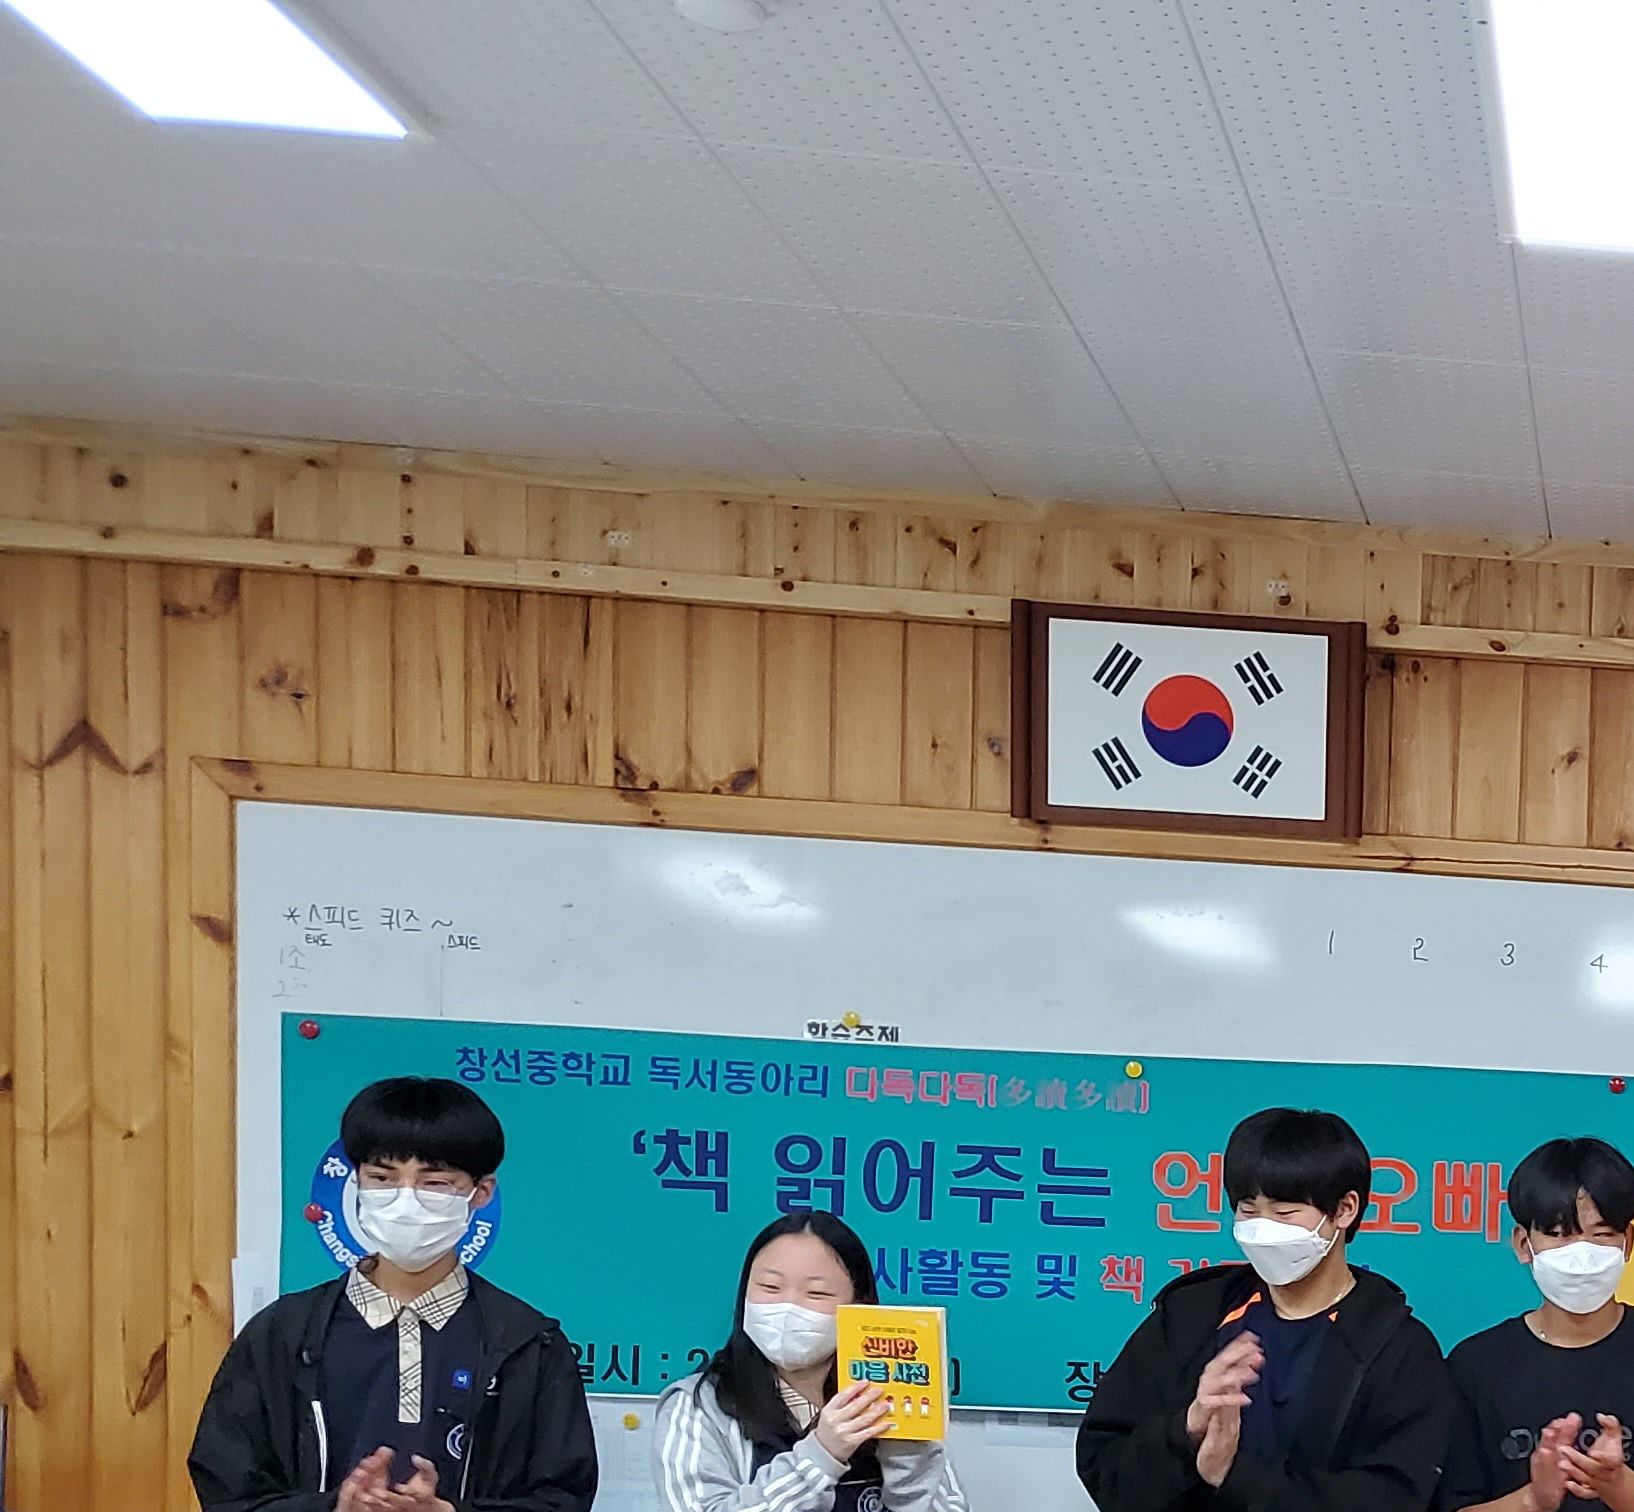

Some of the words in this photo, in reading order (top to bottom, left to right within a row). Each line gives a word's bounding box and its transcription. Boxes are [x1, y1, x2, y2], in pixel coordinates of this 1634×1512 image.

[379, 907, 422, 932] 퀴즈
[1328, 929, 1335, 955] 1
[1412, 937, 1429, 962] 2
[1500, 942, 1516, 966] 3
[1589, 953, 1609, 974] 4
[455, 1047, 632, 1087] 창선중학교
[648, 1055, 830, 1098] 독서동아리
[774, 1134, 1112, 1228] 읽어주는
[1036, 1253, 1077, 1301] 및
[1100, 1255, 1145, 1304] 책
[849, 1360, 889, 1383] 마음
[892, 1361, 930, 1386] 사전
[1064, 1359, 1101, 1402] 장
